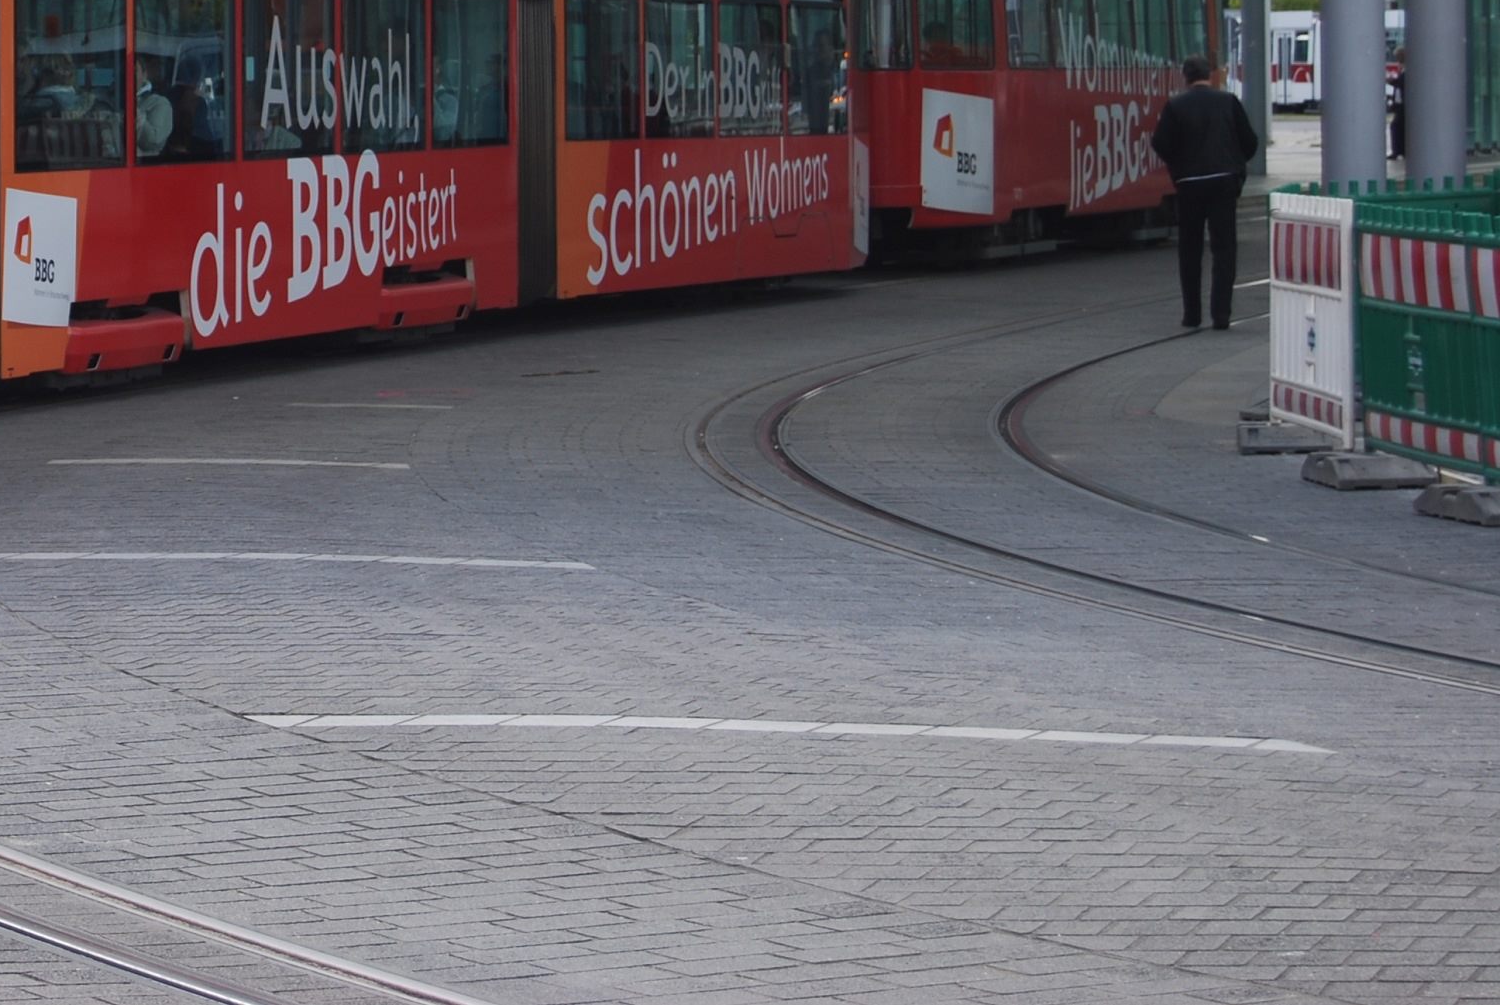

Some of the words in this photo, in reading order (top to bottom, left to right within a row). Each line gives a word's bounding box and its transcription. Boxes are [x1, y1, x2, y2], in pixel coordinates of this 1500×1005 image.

[260, 14, 420, 143] Auswahl,
[645, 41, 690, 118] Der
[1058, 7, 1166, 116] Wohnungen
[586, 147, 737, 286] schönen
[744, 137, 829, 226] Wohnens
[956, 151, 977, 175] BBG
[34, 257, 55, 284] BBG
[190, 183, 272, 337] die
[287, 149, 457, 304] BBGeistert
